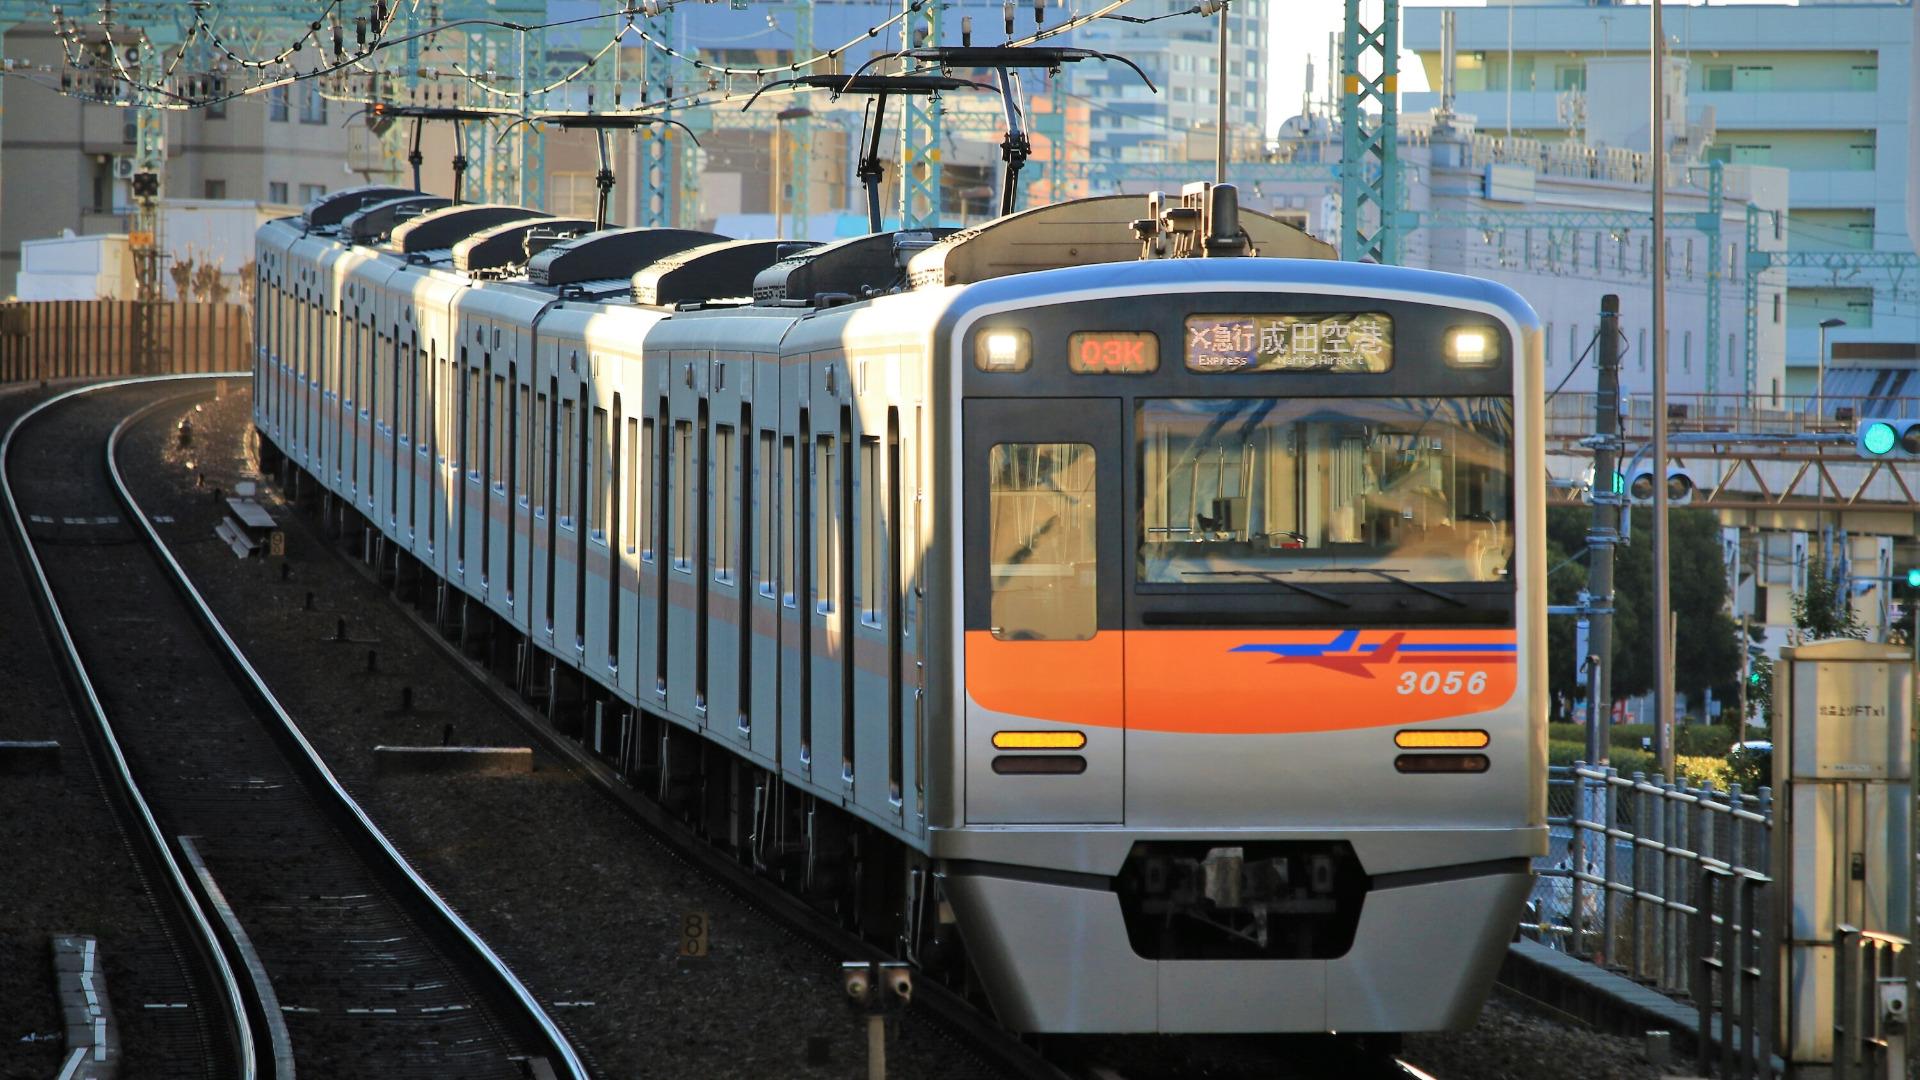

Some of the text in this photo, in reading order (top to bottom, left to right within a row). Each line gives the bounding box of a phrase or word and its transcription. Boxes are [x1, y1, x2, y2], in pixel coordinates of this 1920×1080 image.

[1211, 321, 1383, 355] 急行 成田空港
[1081, 339, 1144, 365] 03K
[1199, 354, 1248, 366] Express
[1319, 354, 1364, 366] Airport
[1396, 671, 1488, 695] 3056
[685, 914, 703, 938] 8
